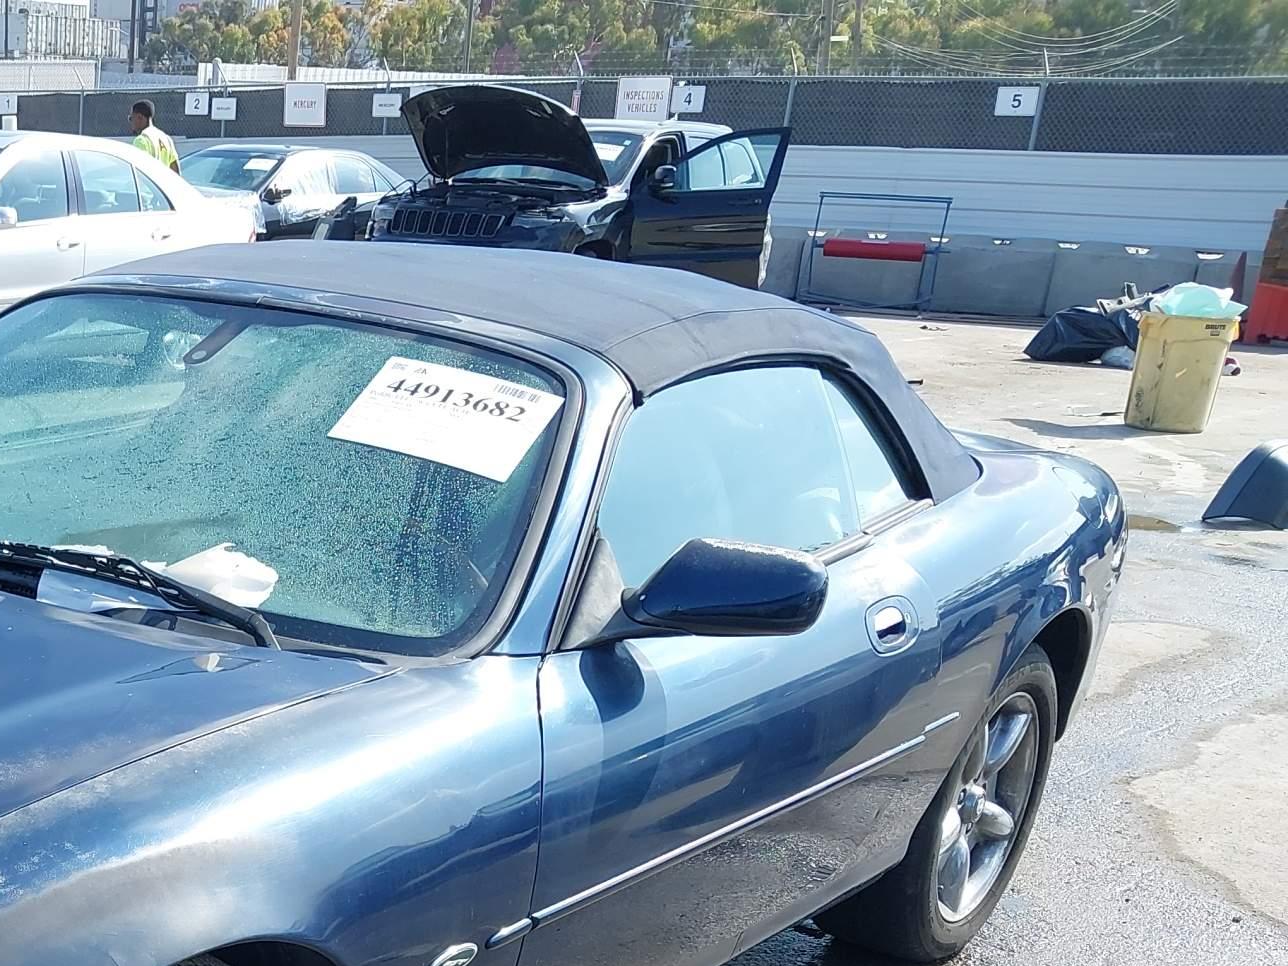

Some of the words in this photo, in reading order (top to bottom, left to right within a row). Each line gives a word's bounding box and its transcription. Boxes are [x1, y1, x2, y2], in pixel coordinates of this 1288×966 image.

[623, 90, 664, 100] INSPECTIONS
[683, 92, 692, 106] 4
[1011, 93, 1023, 109] 5
[5, 98, 10, 110] 1
[194, 98, 200, 110] 2
[386, 378, 527, 423] 44913682
